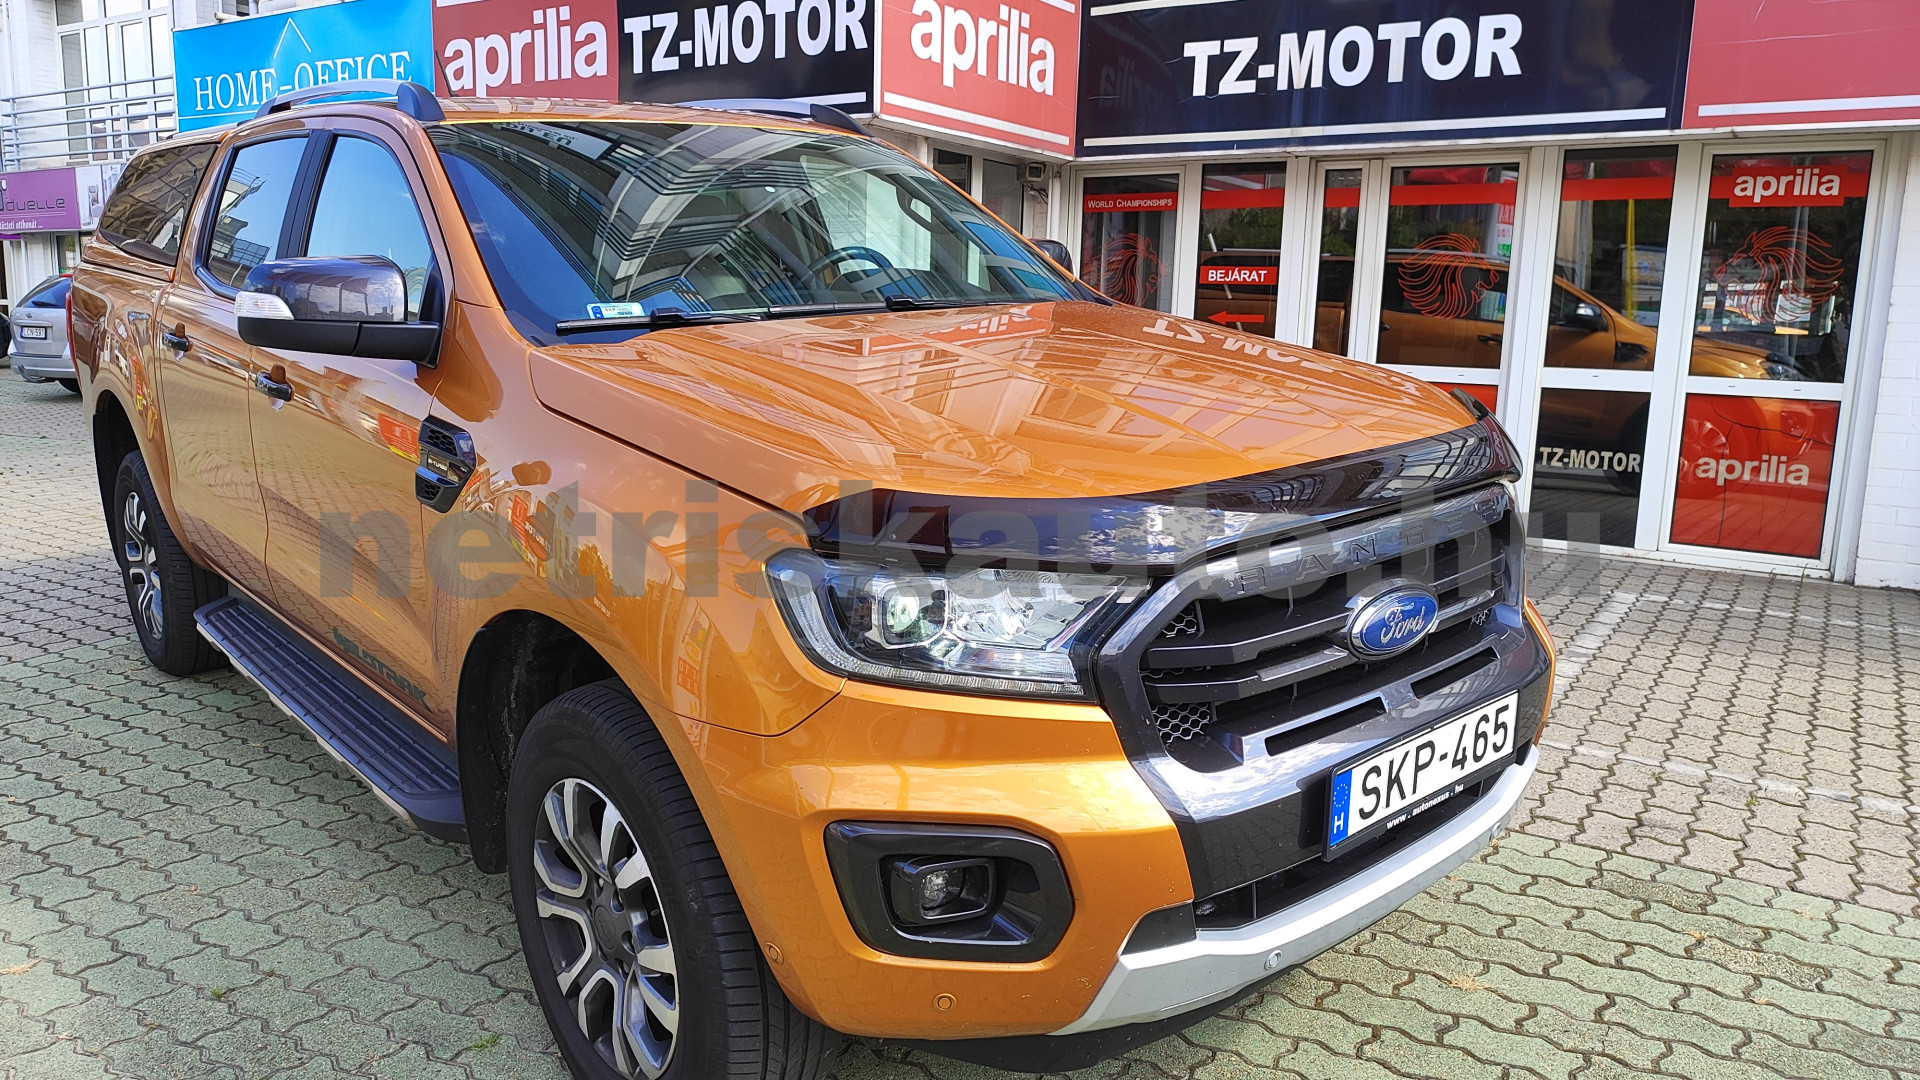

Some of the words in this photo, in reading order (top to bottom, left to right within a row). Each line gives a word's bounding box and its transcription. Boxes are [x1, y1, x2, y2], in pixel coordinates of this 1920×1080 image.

[444, 5, 608, 97] aprilia
[623, 0, 869, 74] TZ-MOTOR
[910, 0, 1055, 96] aprilia
[1183, 12, 1524, 97] TZ-MOTOR
[1733, 168, 1841, 203] aprilia
[1208, 267, 1267, 282] BEJÁRAT
[1539, 446, 1641, 473] TZ-MOTOR
[1695, 454, 1810, 486] aprilia
[1380, 602, 1426, 644] Ford
[1358, 703, 1510, 821] SKP-465
[1333, 812, 1345, 834] H
